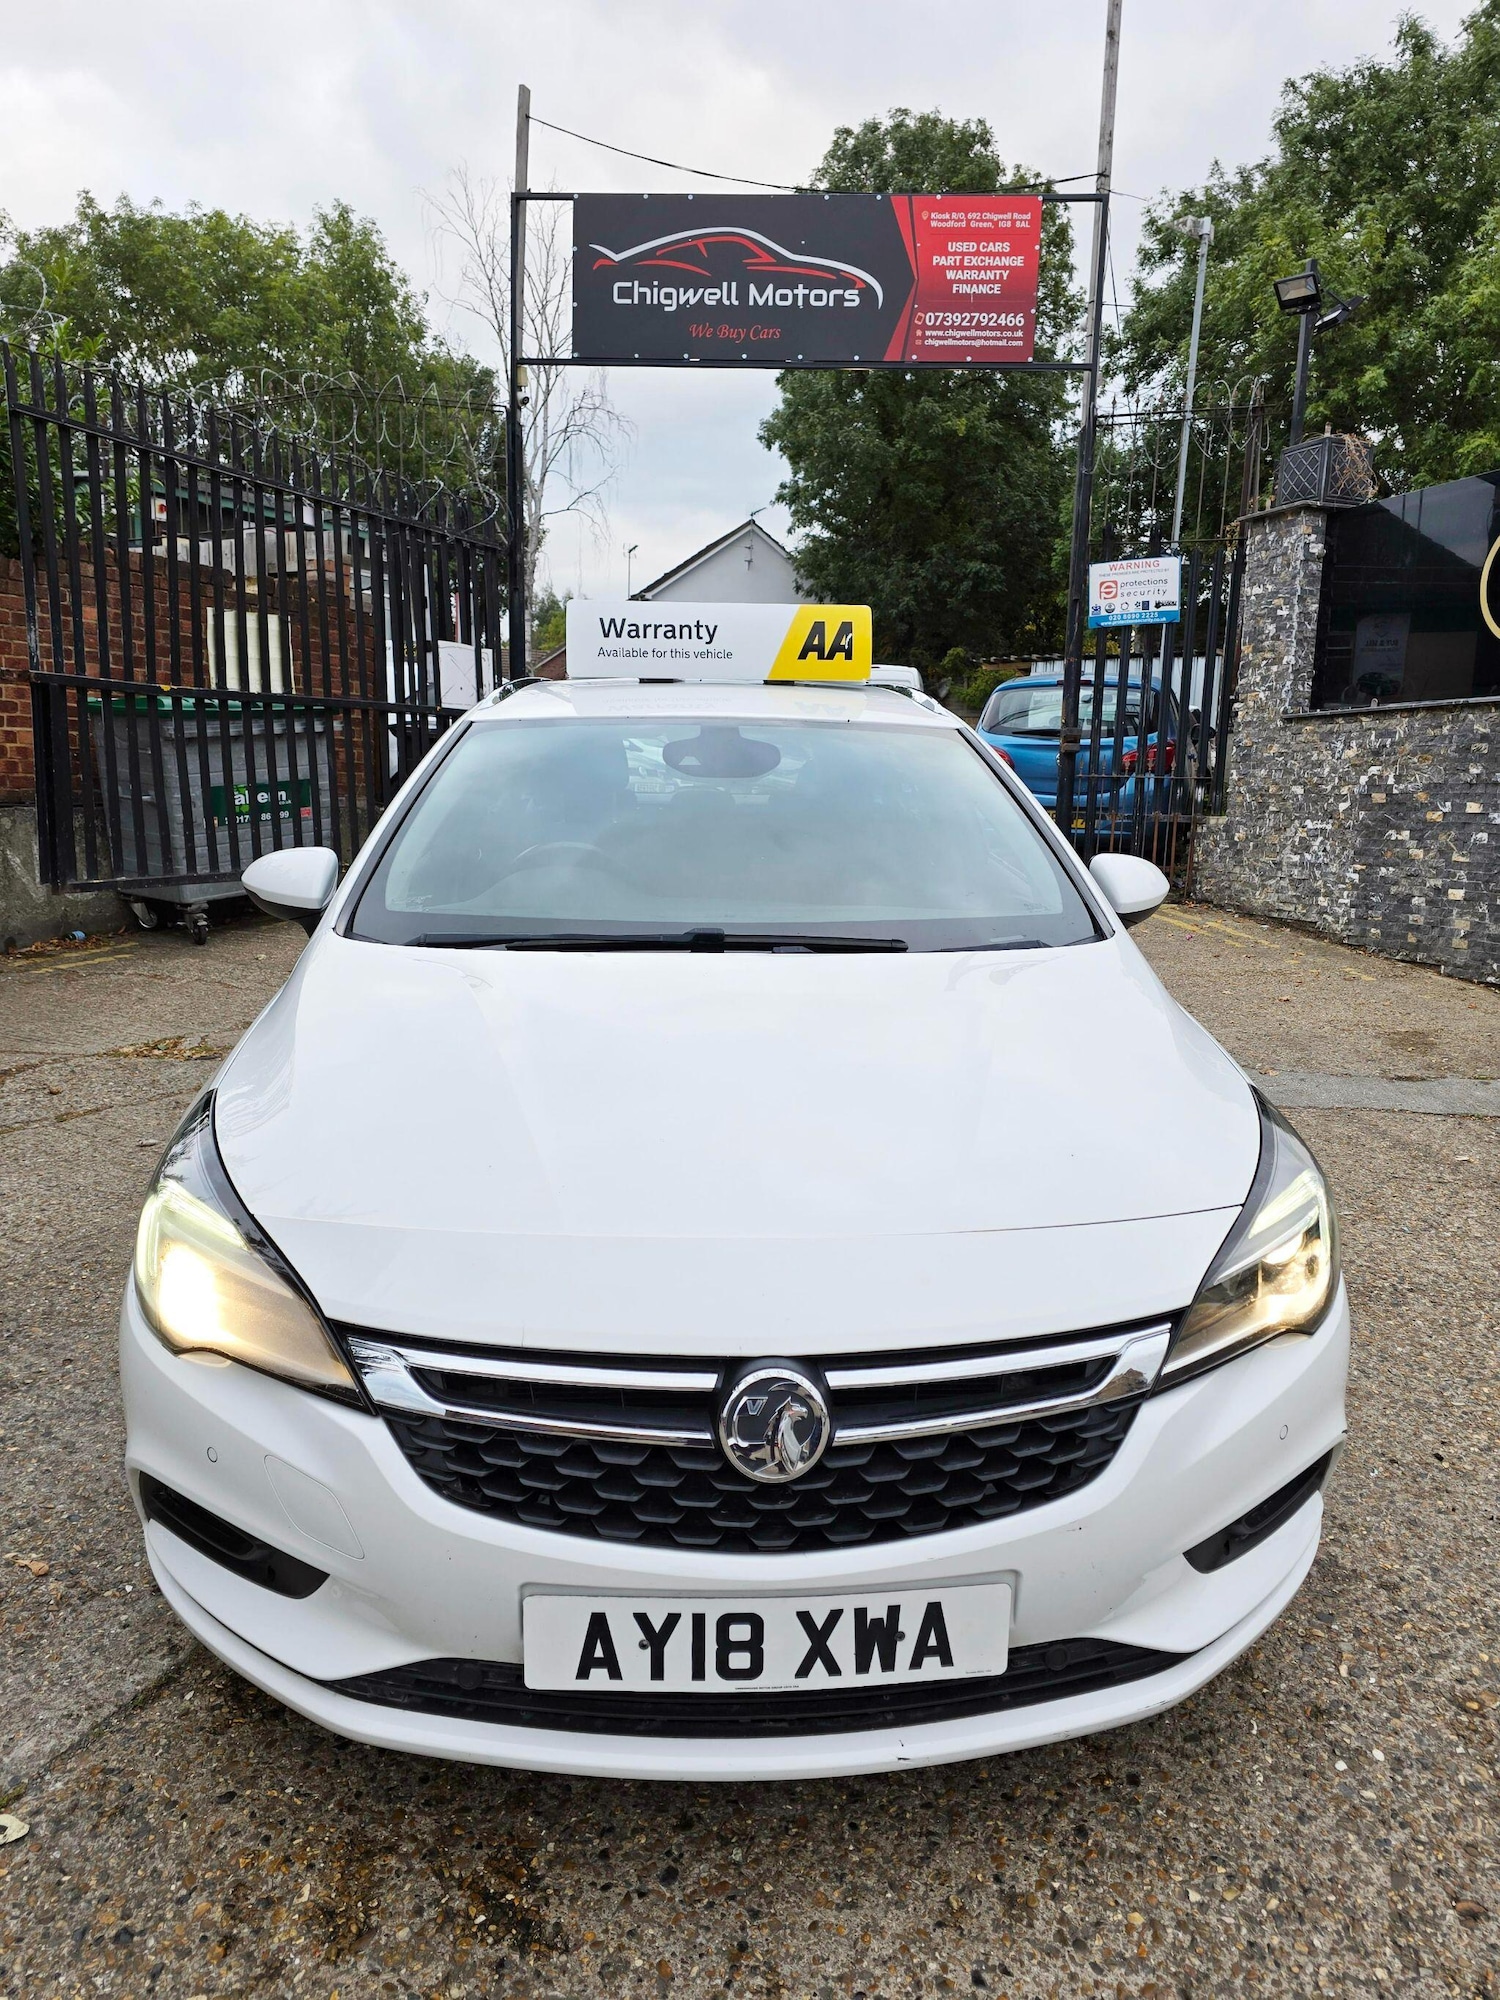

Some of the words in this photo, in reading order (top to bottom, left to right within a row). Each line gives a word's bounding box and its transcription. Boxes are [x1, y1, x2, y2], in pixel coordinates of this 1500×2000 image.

[930, 212, 951, 220] Kiosk
[951, 212, 966, 221] R/O,
[967, 212, 980, 220] 692
[982, 212, 1012, 221] Chigwell
[1013, 212, 1031, 220] Road
[930, 220, 966, 228] Woodford
[970, 220, 995, 229] Green,
[998, 220, 1012, 228] IG8
[1015, 220, 1031, 228] 8AL
[947, 242, 977, 252] USED
[979, 242, 1011, 252] CARS
[932, 256, 962, 266] PART
[963, 256, 1025, 266] EXCHANGE
[945, 270, 1010, 280] WARRANTY
[952, 283, 1002, 294] FINANCE
[612, 279, 739, 312] Chigwell
[748, 283, 861, 308] Motors
[925, 312, 1025, 327] 07392792466
[689, 323, 713, 339] We
[717, 325, 747, 343] Buy
[749, 324, 782, 340] Cars
[924, 329, 1024, 339] www.chigwellmotors.co.uk
[924, 338, 1024, 347] chigwellmotors@hotmail.com
[1109, 560, 1160, 571] WARNING
[1120, 578, 1168, 588] protections
[1120, 588, 1167, 597] security
[598, 617, 718, 645] Warranty
[797, 621, 853, 661] AA
[597, 646, 649, 658] Available
[651, 647, 668, 658] for
[670, 647, 691, 659] this
[693, 648, 733, 660] vehicle
[574, 1611, 765, 1681] AY18
[794, 1601, 954, 1679] XWA
